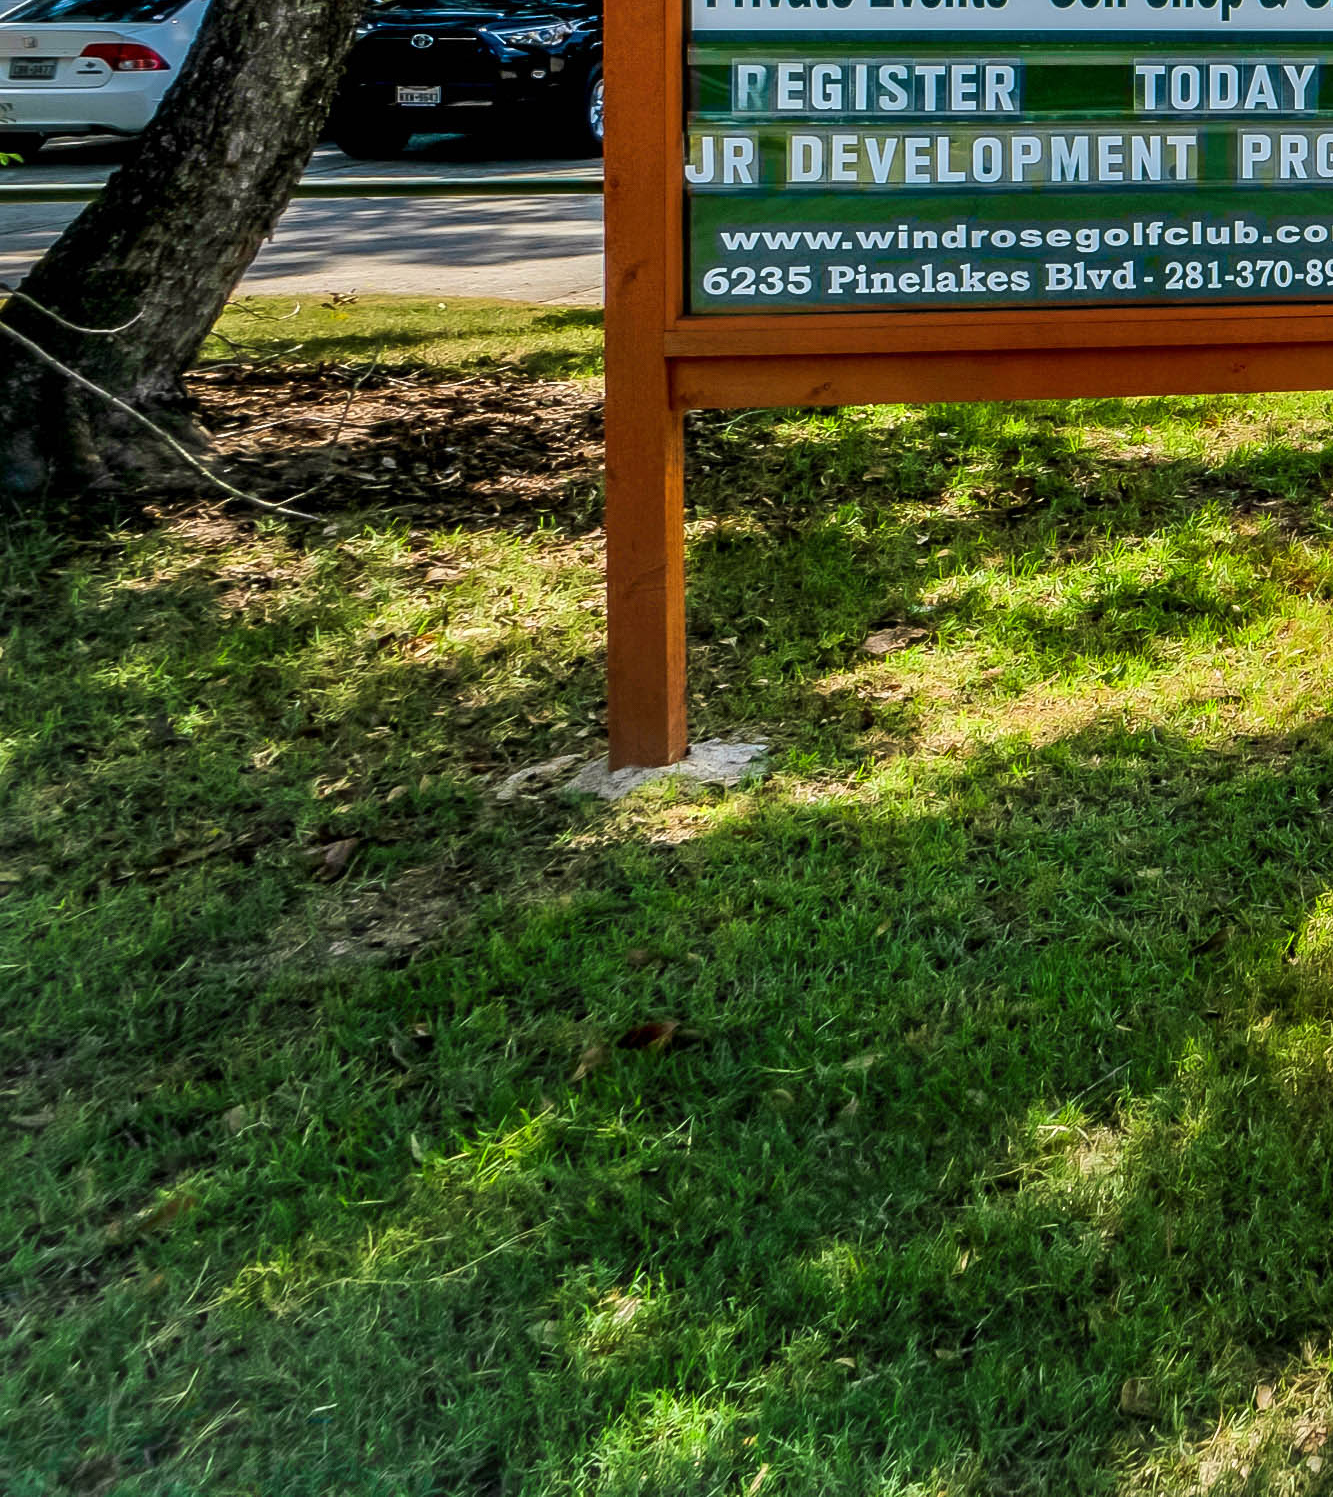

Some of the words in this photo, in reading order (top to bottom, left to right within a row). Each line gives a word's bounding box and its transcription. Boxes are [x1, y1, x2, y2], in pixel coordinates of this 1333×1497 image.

[737, 62, 1016, 111] REGISTER
[1135, 64, 1316, 111] TODAY
[684, 135, 755, 184] JR
[791, 133, 1197, 184] DEVELOPMENT
[702, 267, 813, 296] 6235
[827, 265, 1030, 296] Pinelakes
[1045, 263, 1137, 292] Blvd
